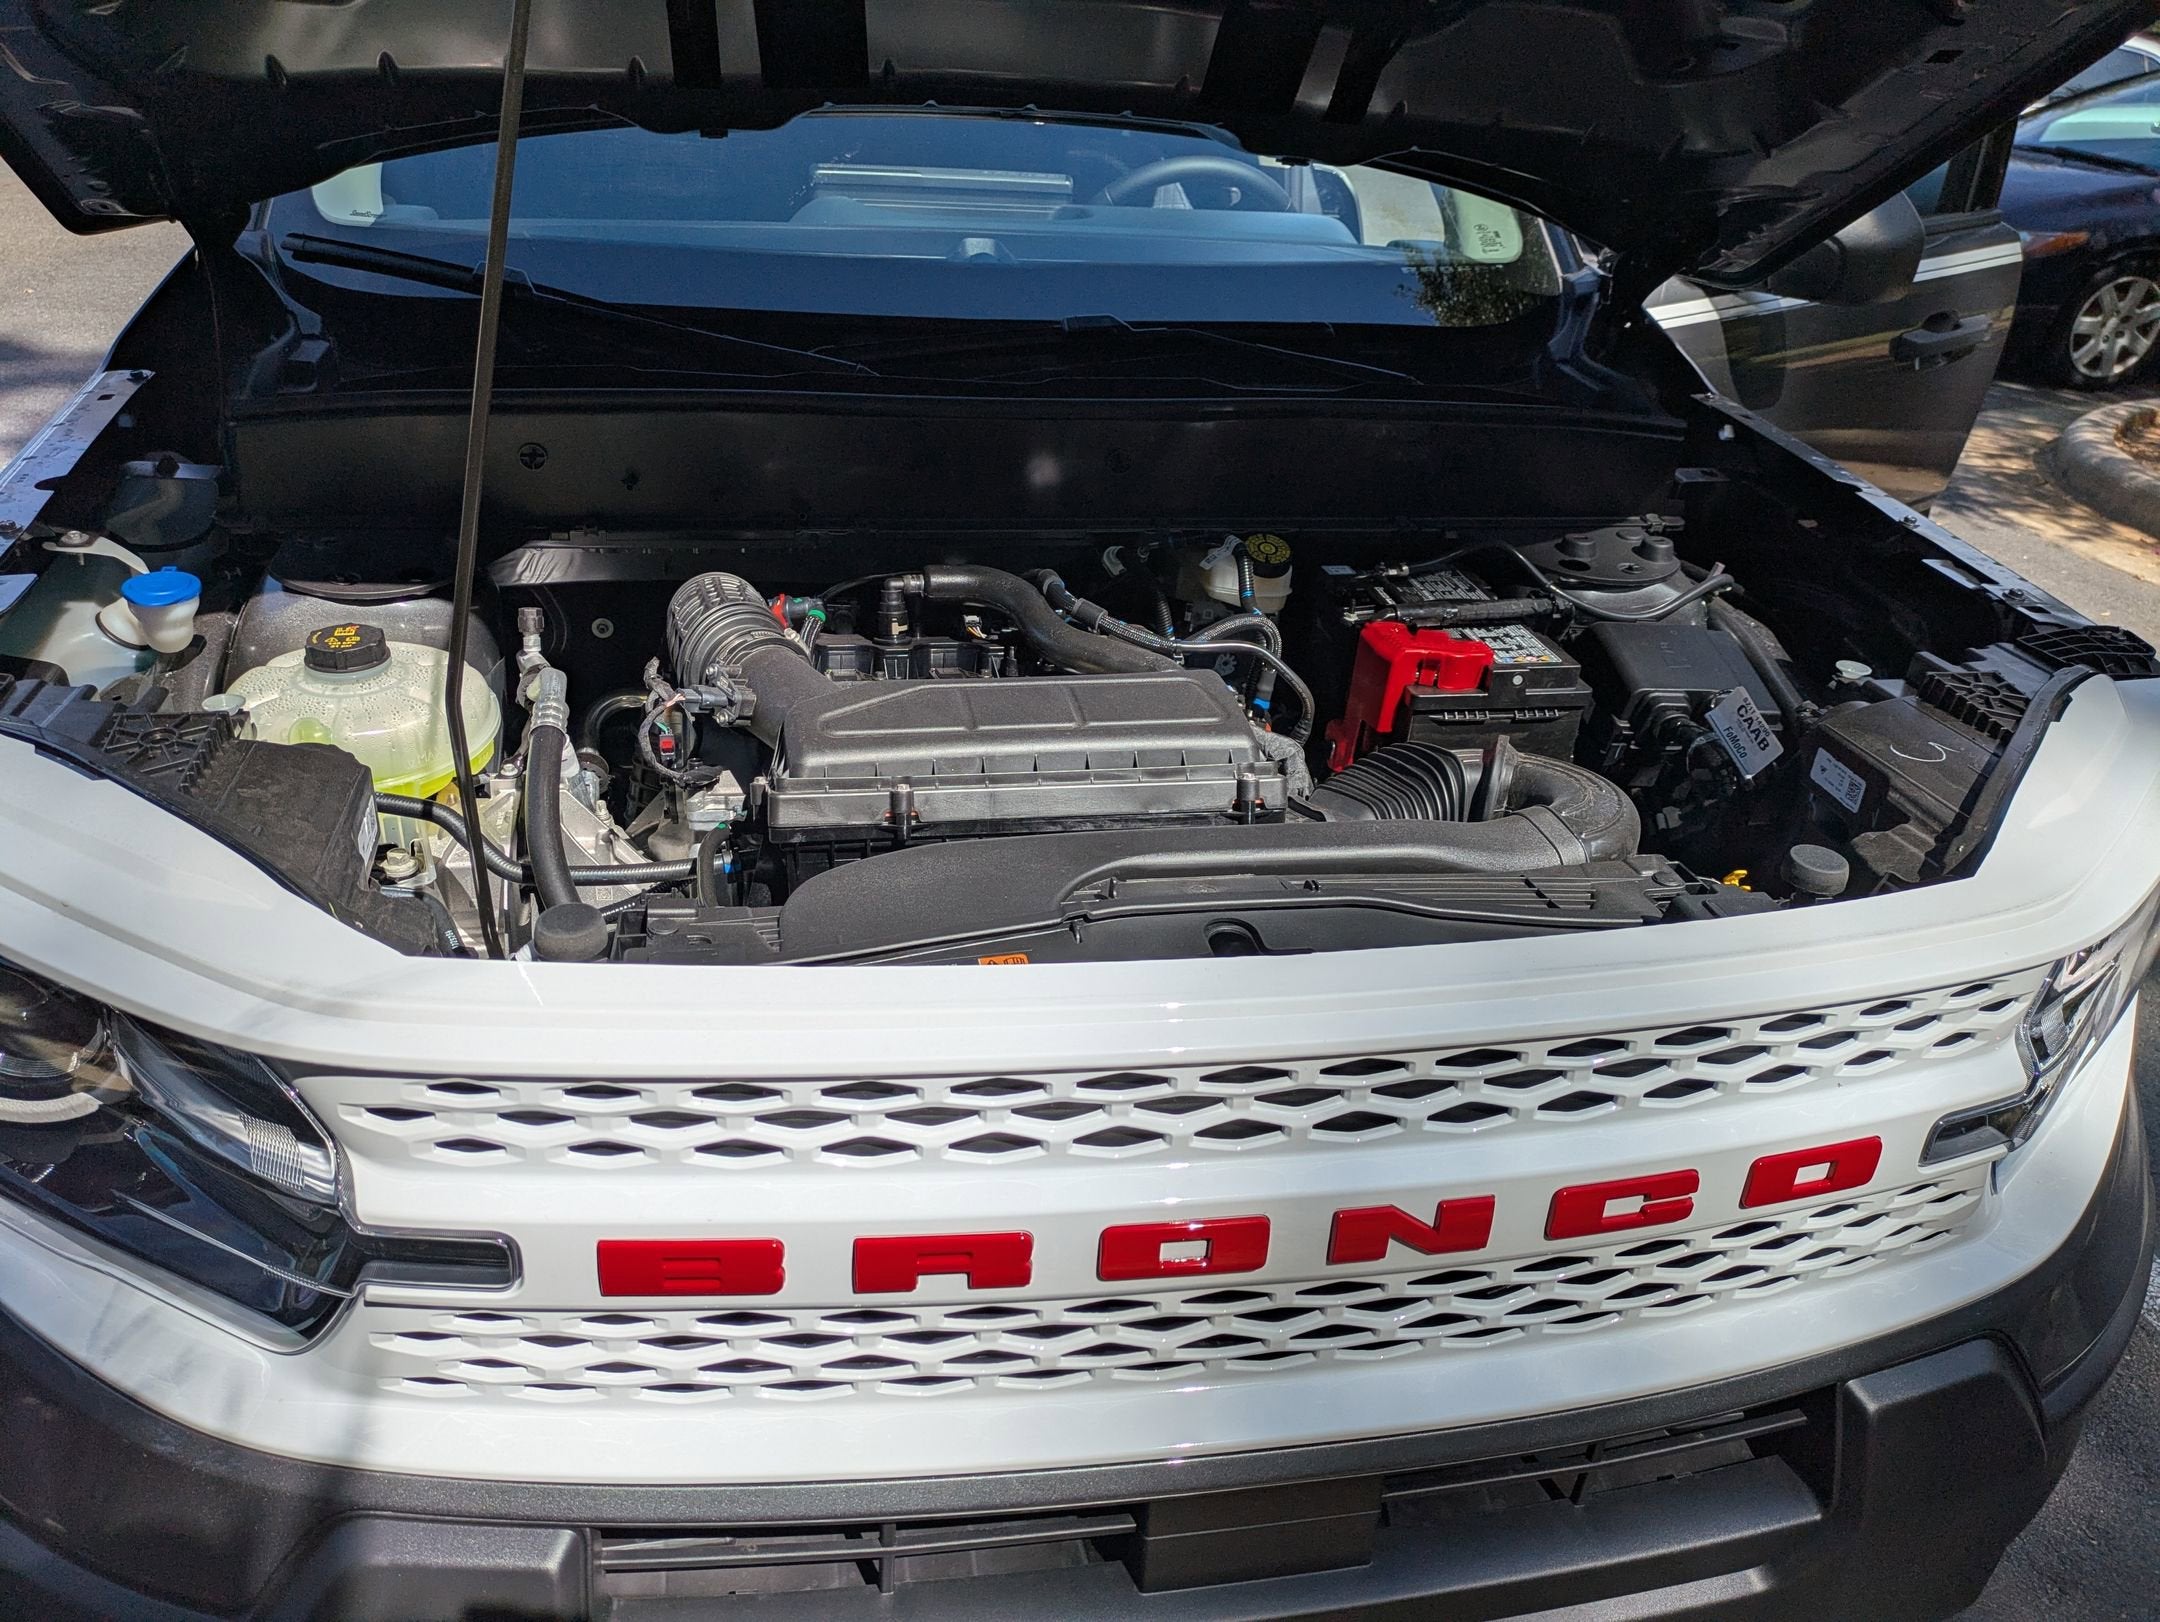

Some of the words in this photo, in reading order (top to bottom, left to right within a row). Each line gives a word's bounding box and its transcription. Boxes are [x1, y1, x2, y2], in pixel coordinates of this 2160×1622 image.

[1723, 726, 1748, 759] FoMoCo
[1736, 704, 1770, 751] CAAB
[597, 1135, 1883, 1297] BRONCO
